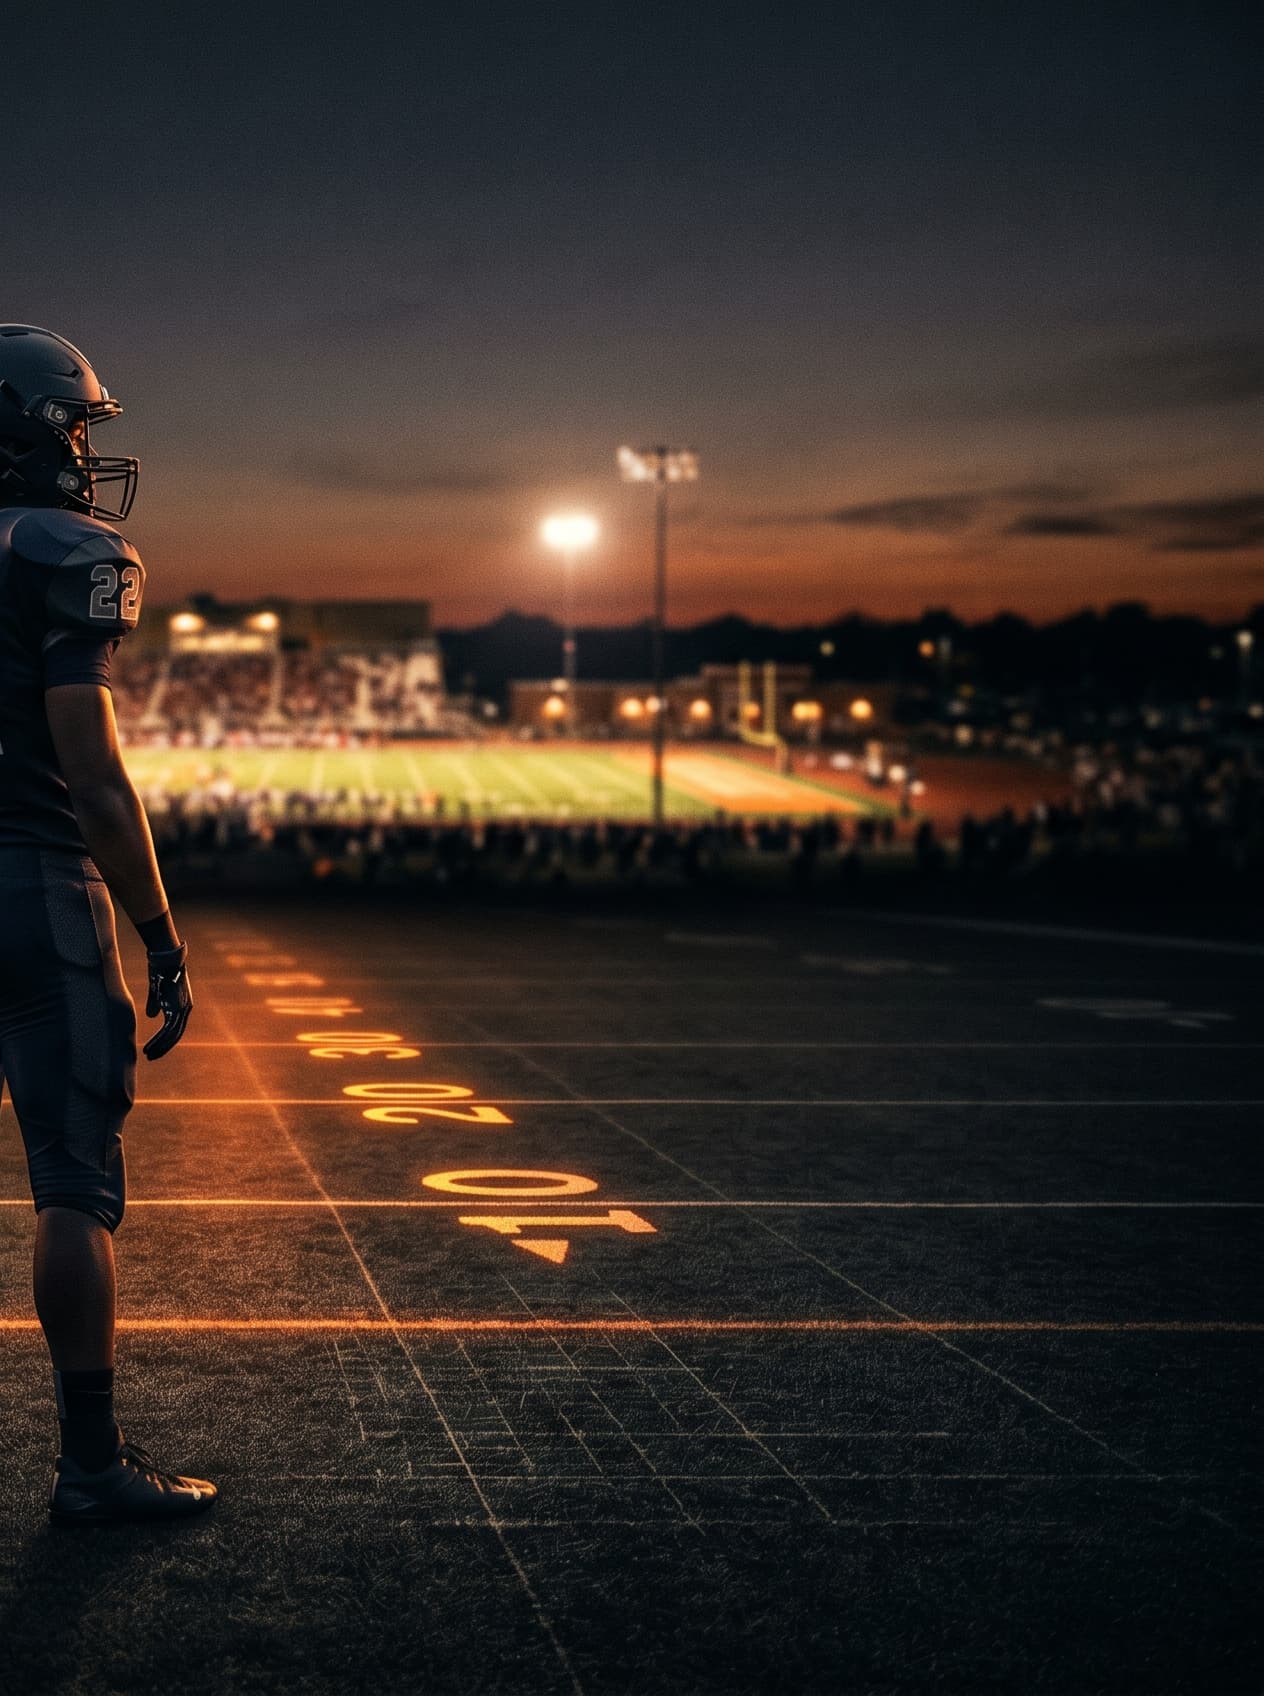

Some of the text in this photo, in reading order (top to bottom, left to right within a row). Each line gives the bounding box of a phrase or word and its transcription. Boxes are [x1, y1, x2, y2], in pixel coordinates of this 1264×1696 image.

[89, 564, 140, 621] 22
[295, 1031, 422, 1059] 30
[342, 1082, 514, 1125] 20
[421, 1168, 658, 1234] 10
